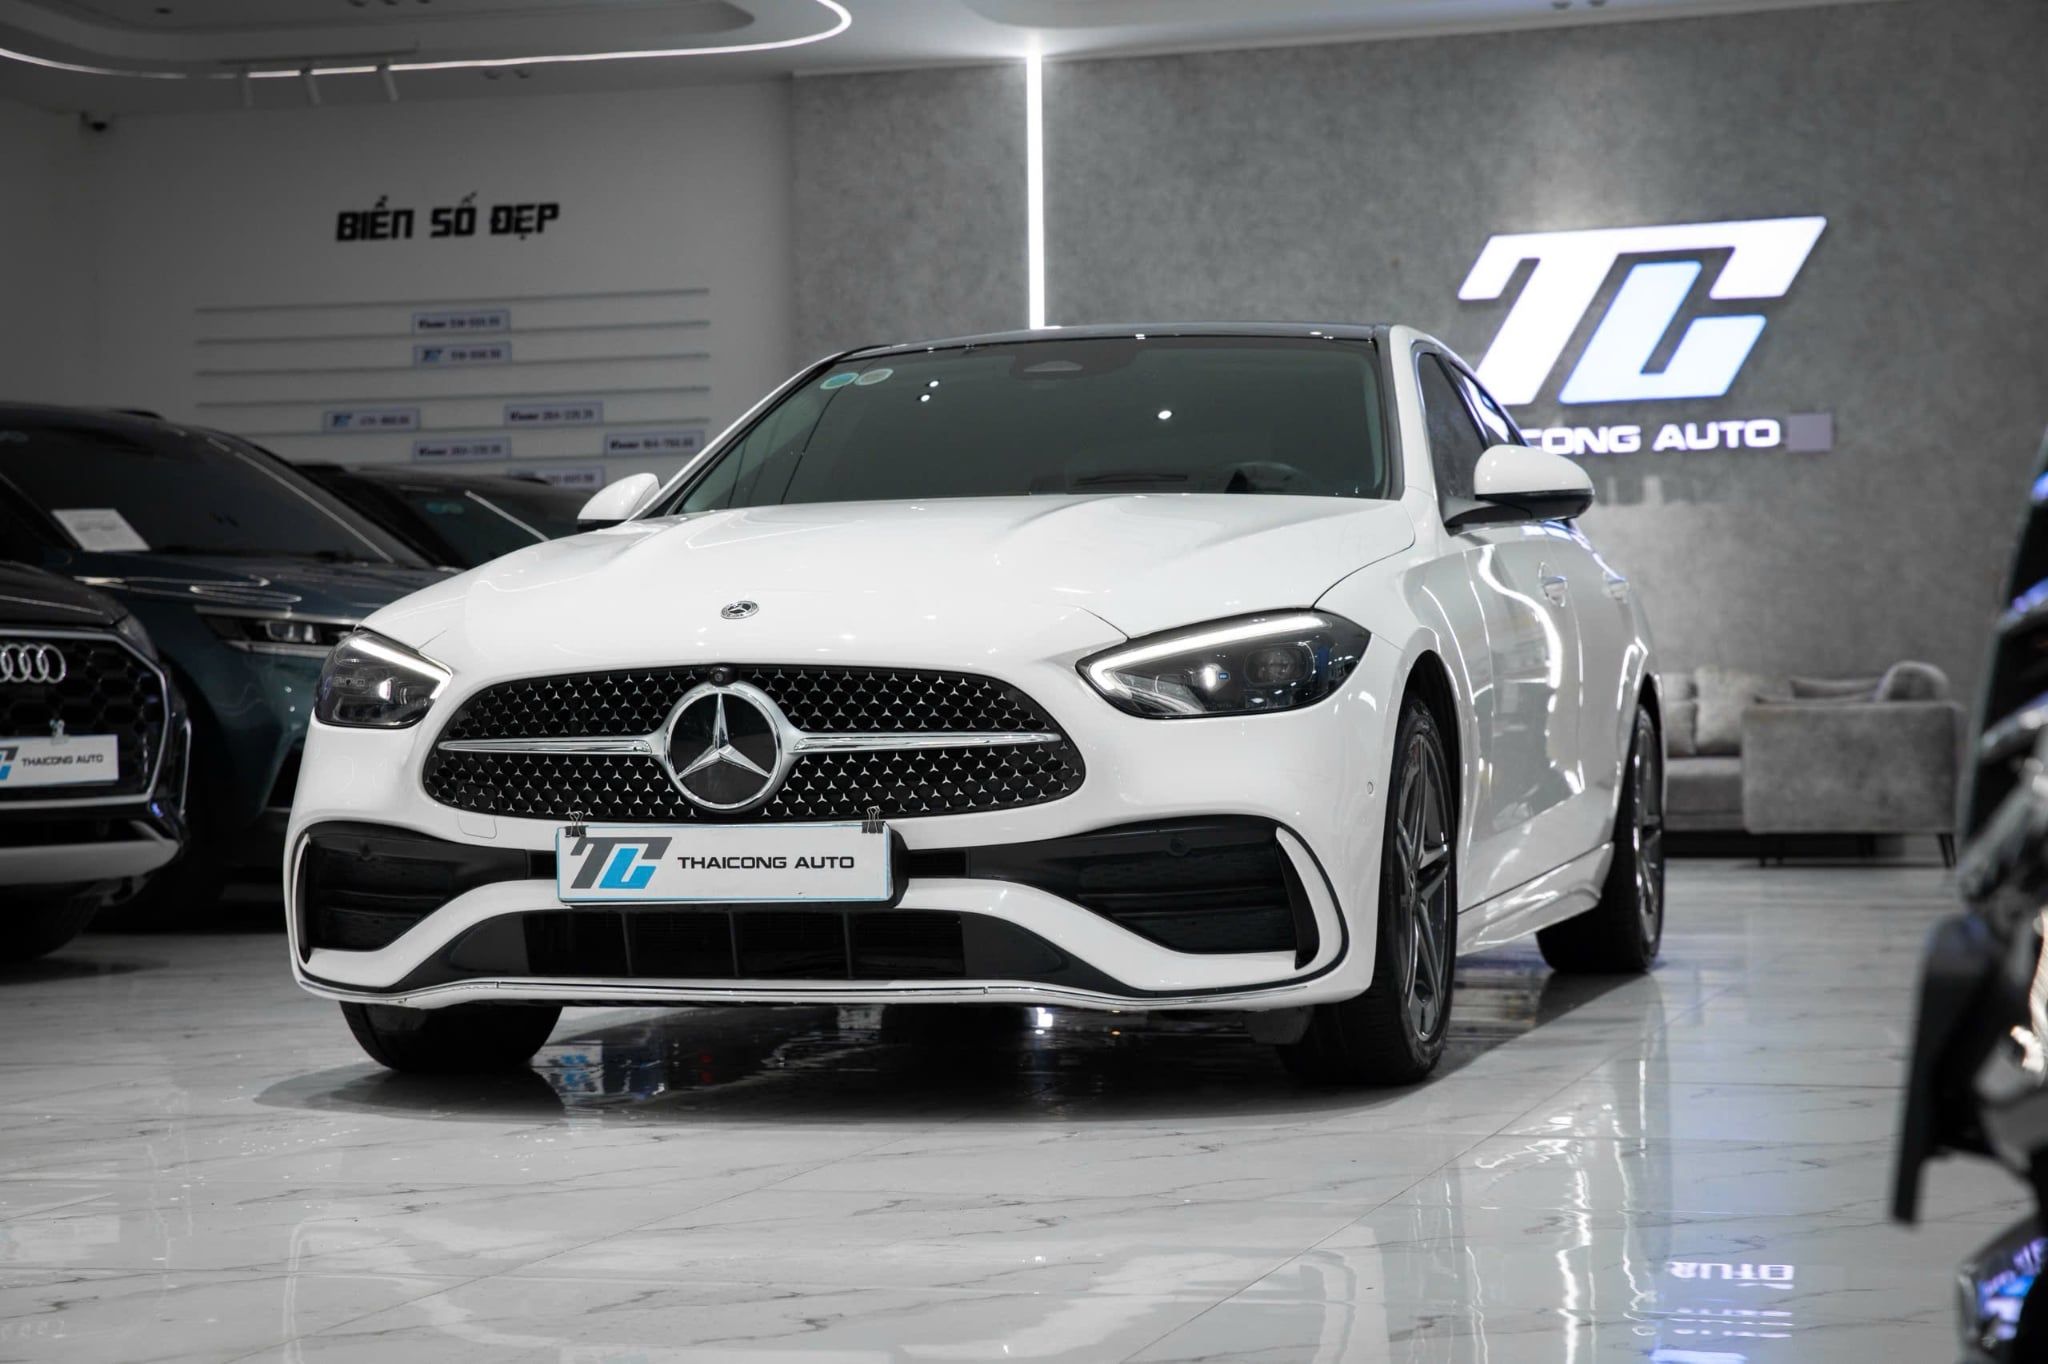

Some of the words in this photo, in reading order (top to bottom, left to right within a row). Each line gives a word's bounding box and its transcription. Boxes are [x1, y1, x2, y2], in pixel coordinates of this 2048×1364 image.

[335, 195, 415, 242] BIỂN
[430, 191, 478, 238] SỐ
[489, 203, 560, 241] ĐẸP
[1652, 418, 1782, 452] AUTO
[21, 756, 74, 768] THAICONG
[76, 753, 104, 764] AUTO
[677, 856, 787, 870] THAICONG
[794, 855, 856, 870] AUTO
